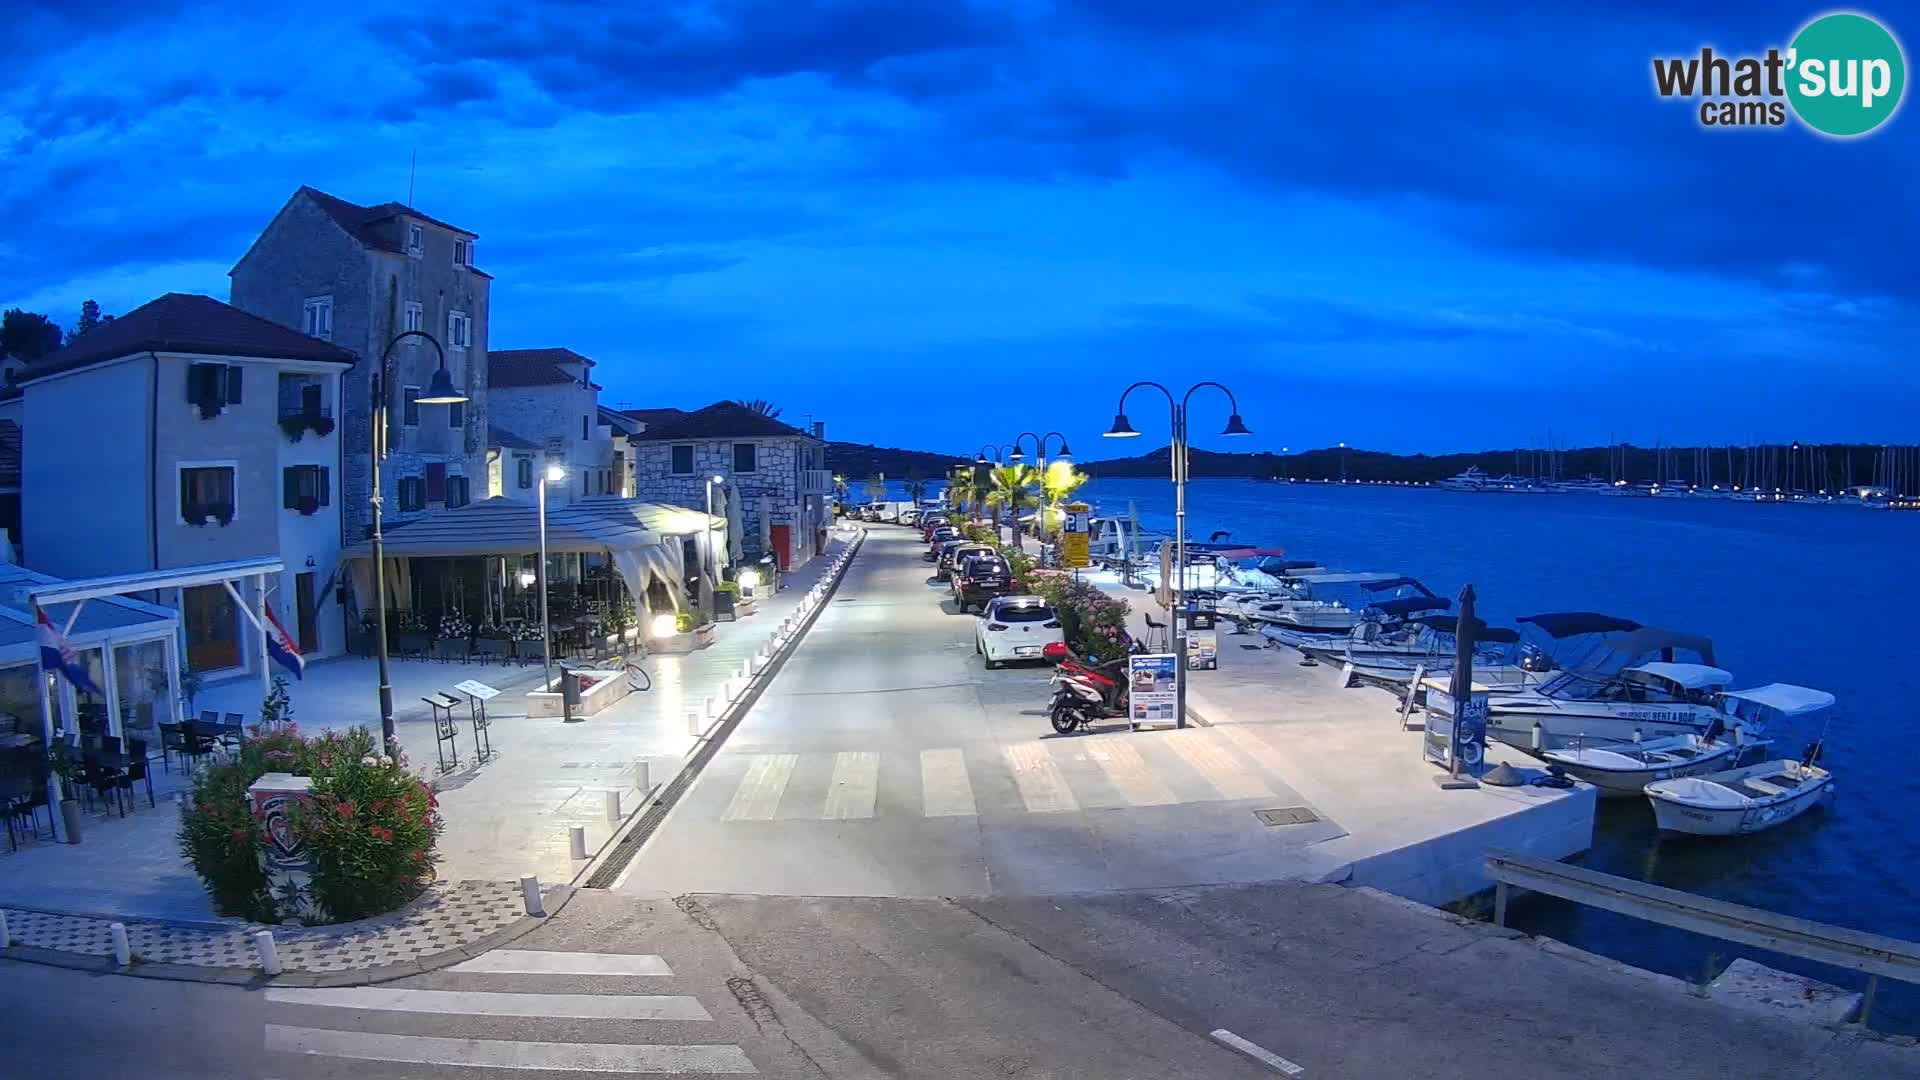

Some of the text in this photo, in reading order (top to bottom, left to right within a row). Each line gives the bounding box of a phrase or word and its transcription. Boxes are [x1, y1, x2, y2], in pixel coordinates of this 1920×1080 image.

[1652, 711, 1671, 721] RENT
[1672, 712, 1677, 721] A
[1678, 711, 1697, 722] BOAT
